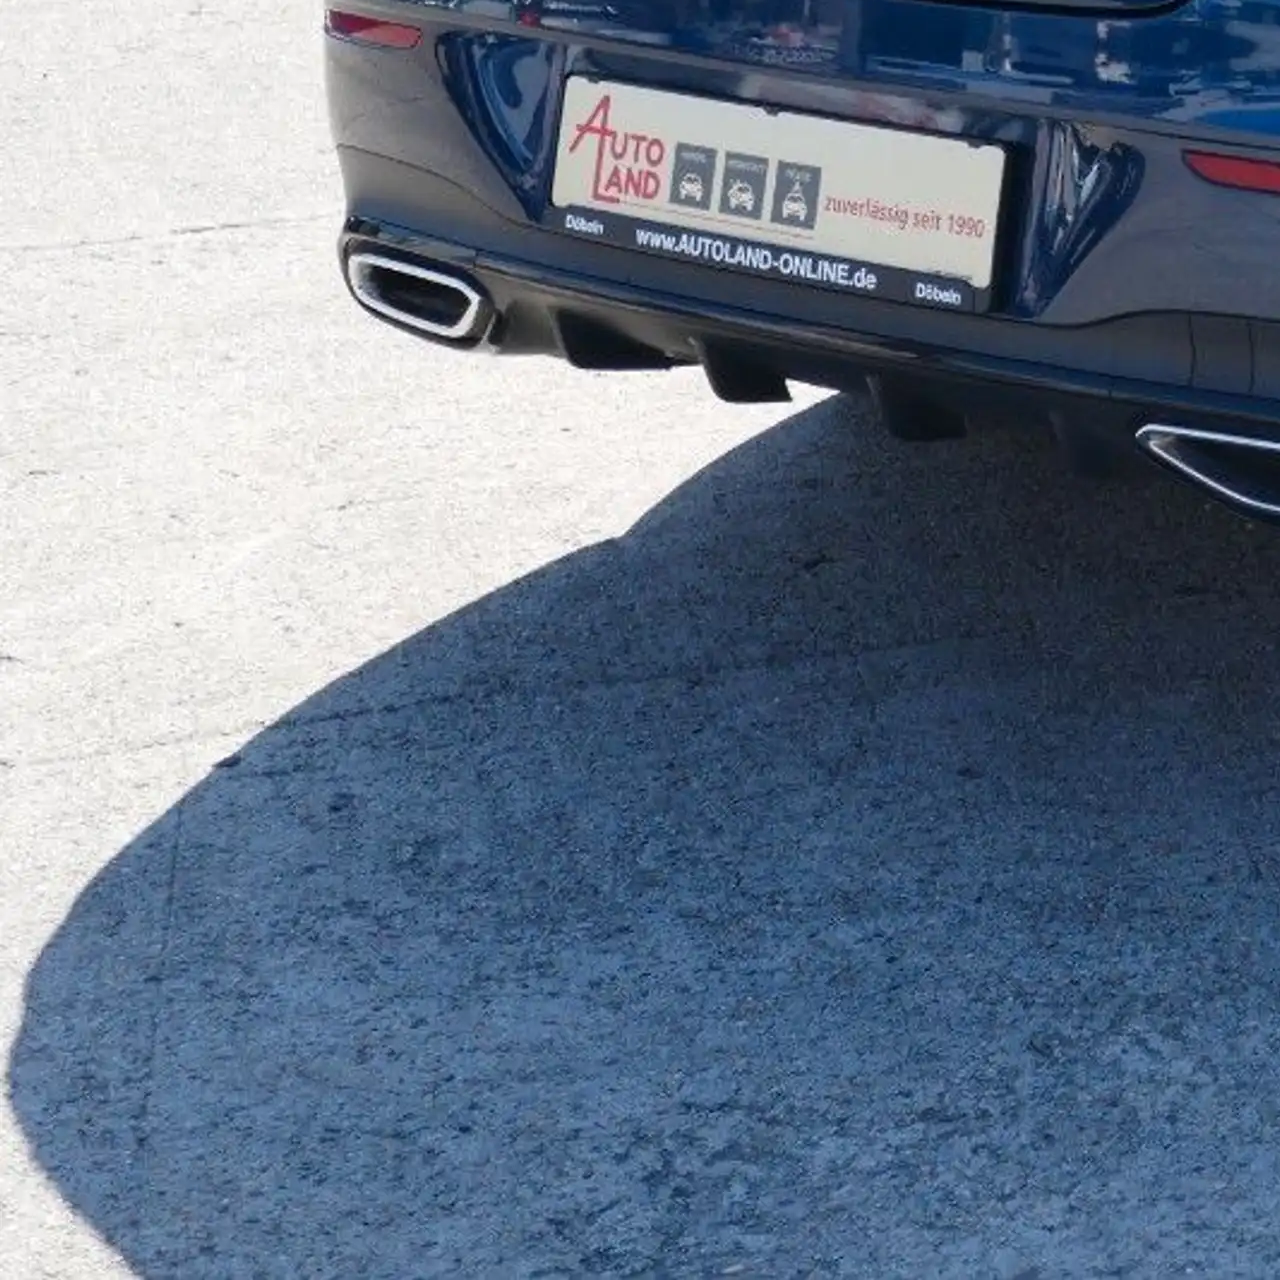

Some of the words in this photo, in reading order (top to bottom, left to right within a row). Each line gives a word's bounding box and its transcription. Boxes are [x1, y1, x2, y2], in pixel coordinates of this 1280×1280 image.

[569, 95, 665, 167] AUTO
[592, 138, 660, 203] LAND
[825, 197, 909, 230] zuverlässig
[913, 210, 942, 231] seit
[949, 215, 985, 238] 1990
[636, 228, 877, 289] www.AUTOLAND-ONLINE.de
